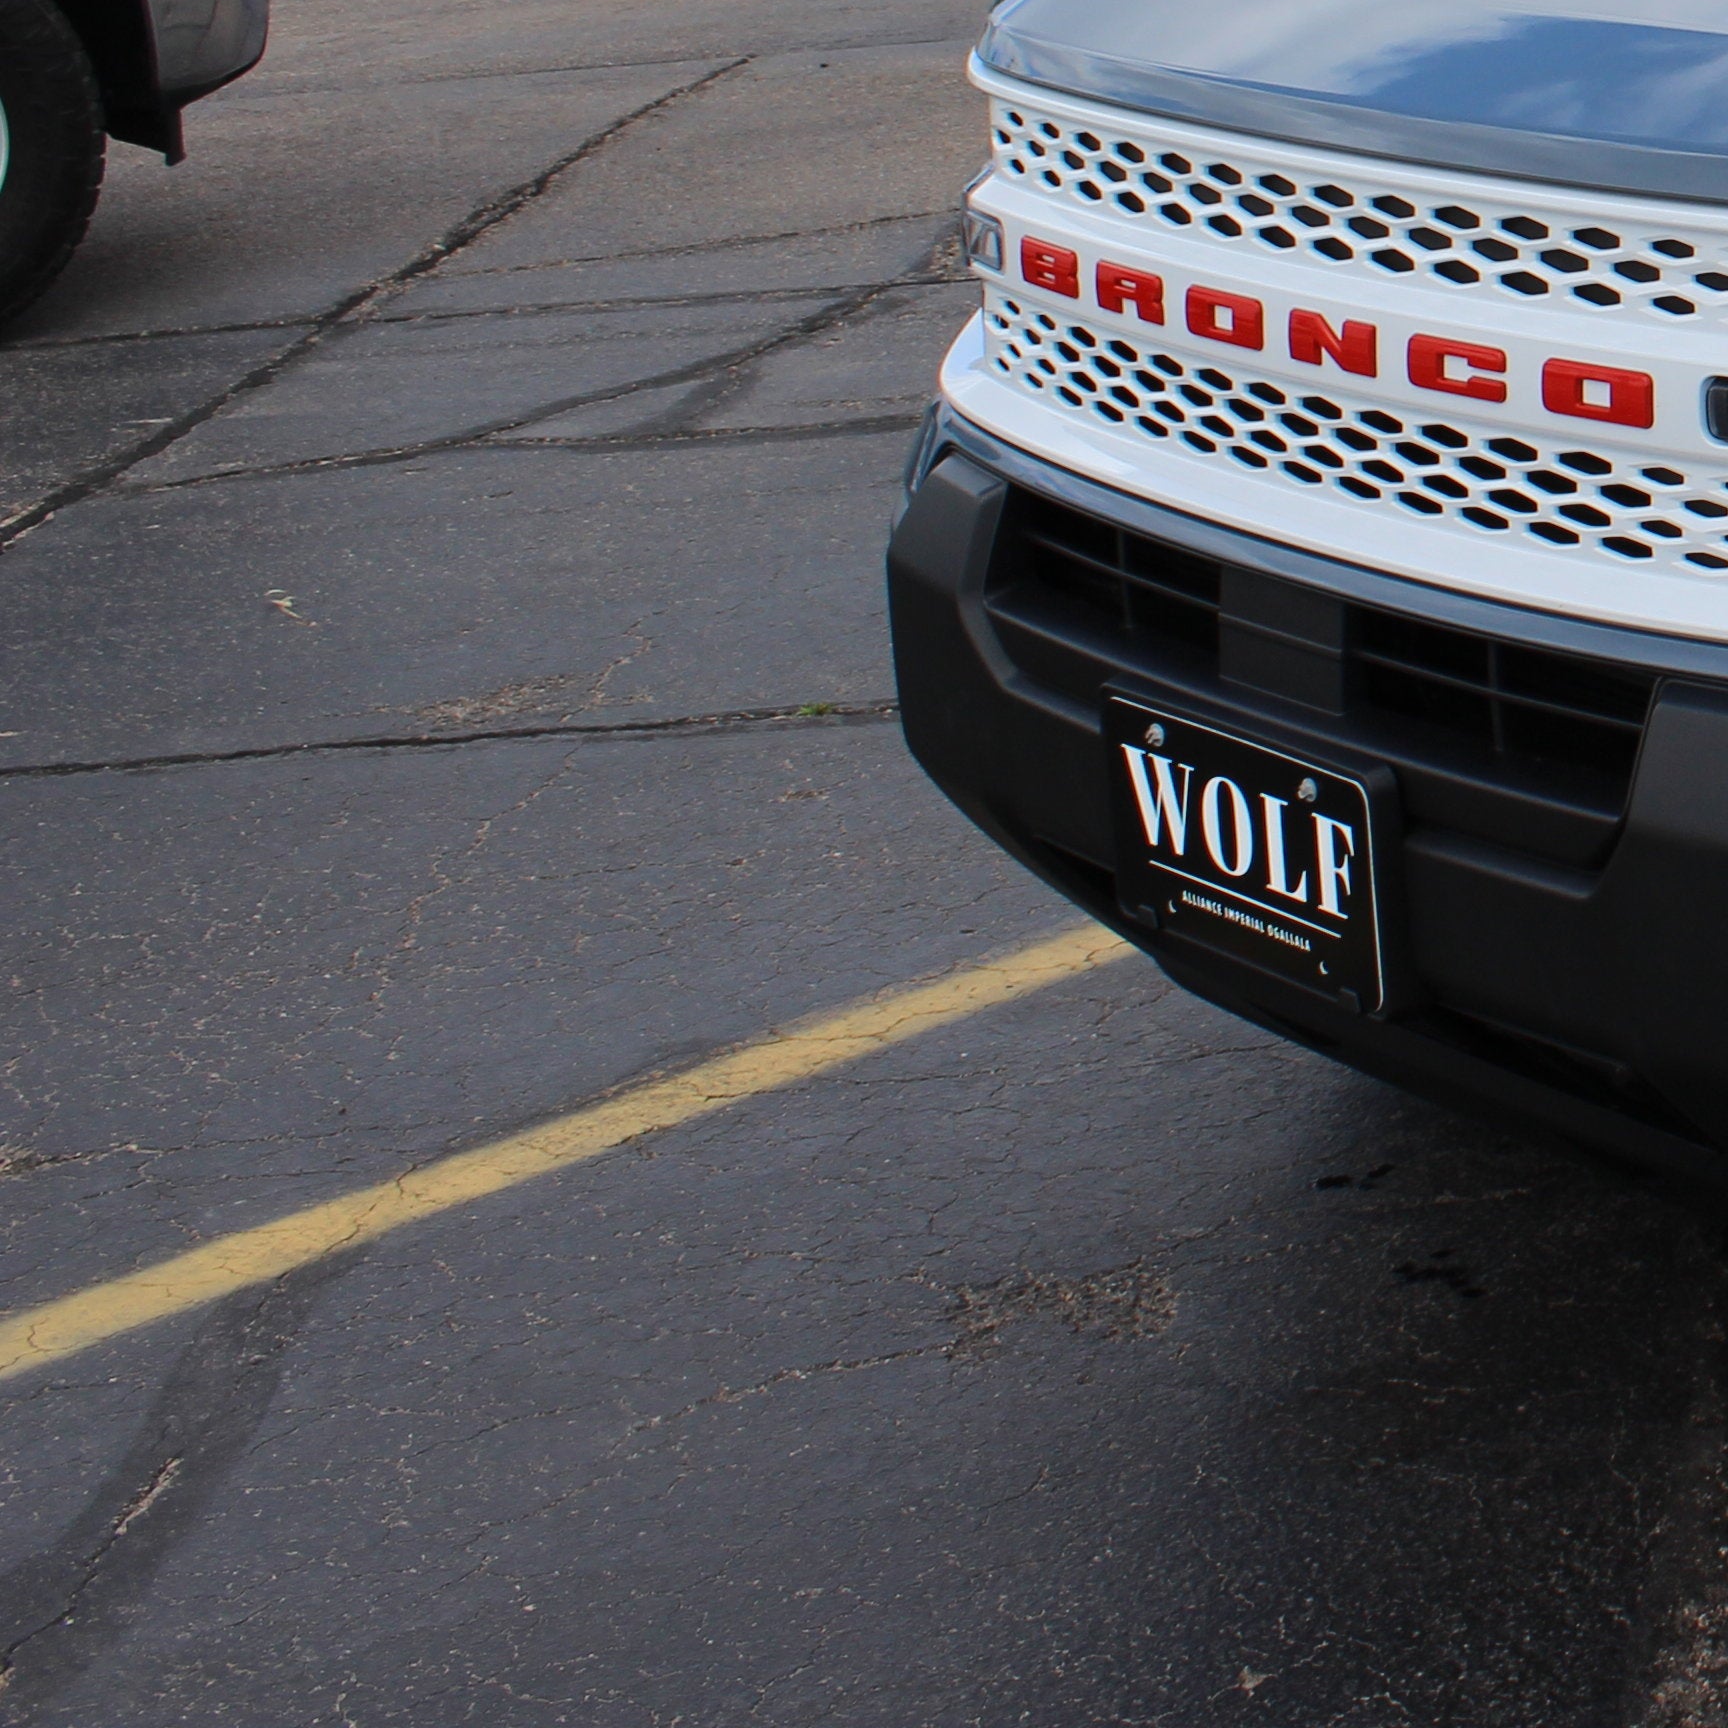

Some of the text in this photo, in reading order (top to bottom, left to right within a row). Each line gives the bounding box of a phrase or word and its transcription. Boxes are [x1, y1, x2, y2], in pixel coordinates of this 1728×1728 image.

[1019, 234, 1654, 430] BRONCO
[1119, 743, 1357, 921] WOLF
[1182, 889, 1311, 952] ALLIANCE IMPERIAL OGALLALA
